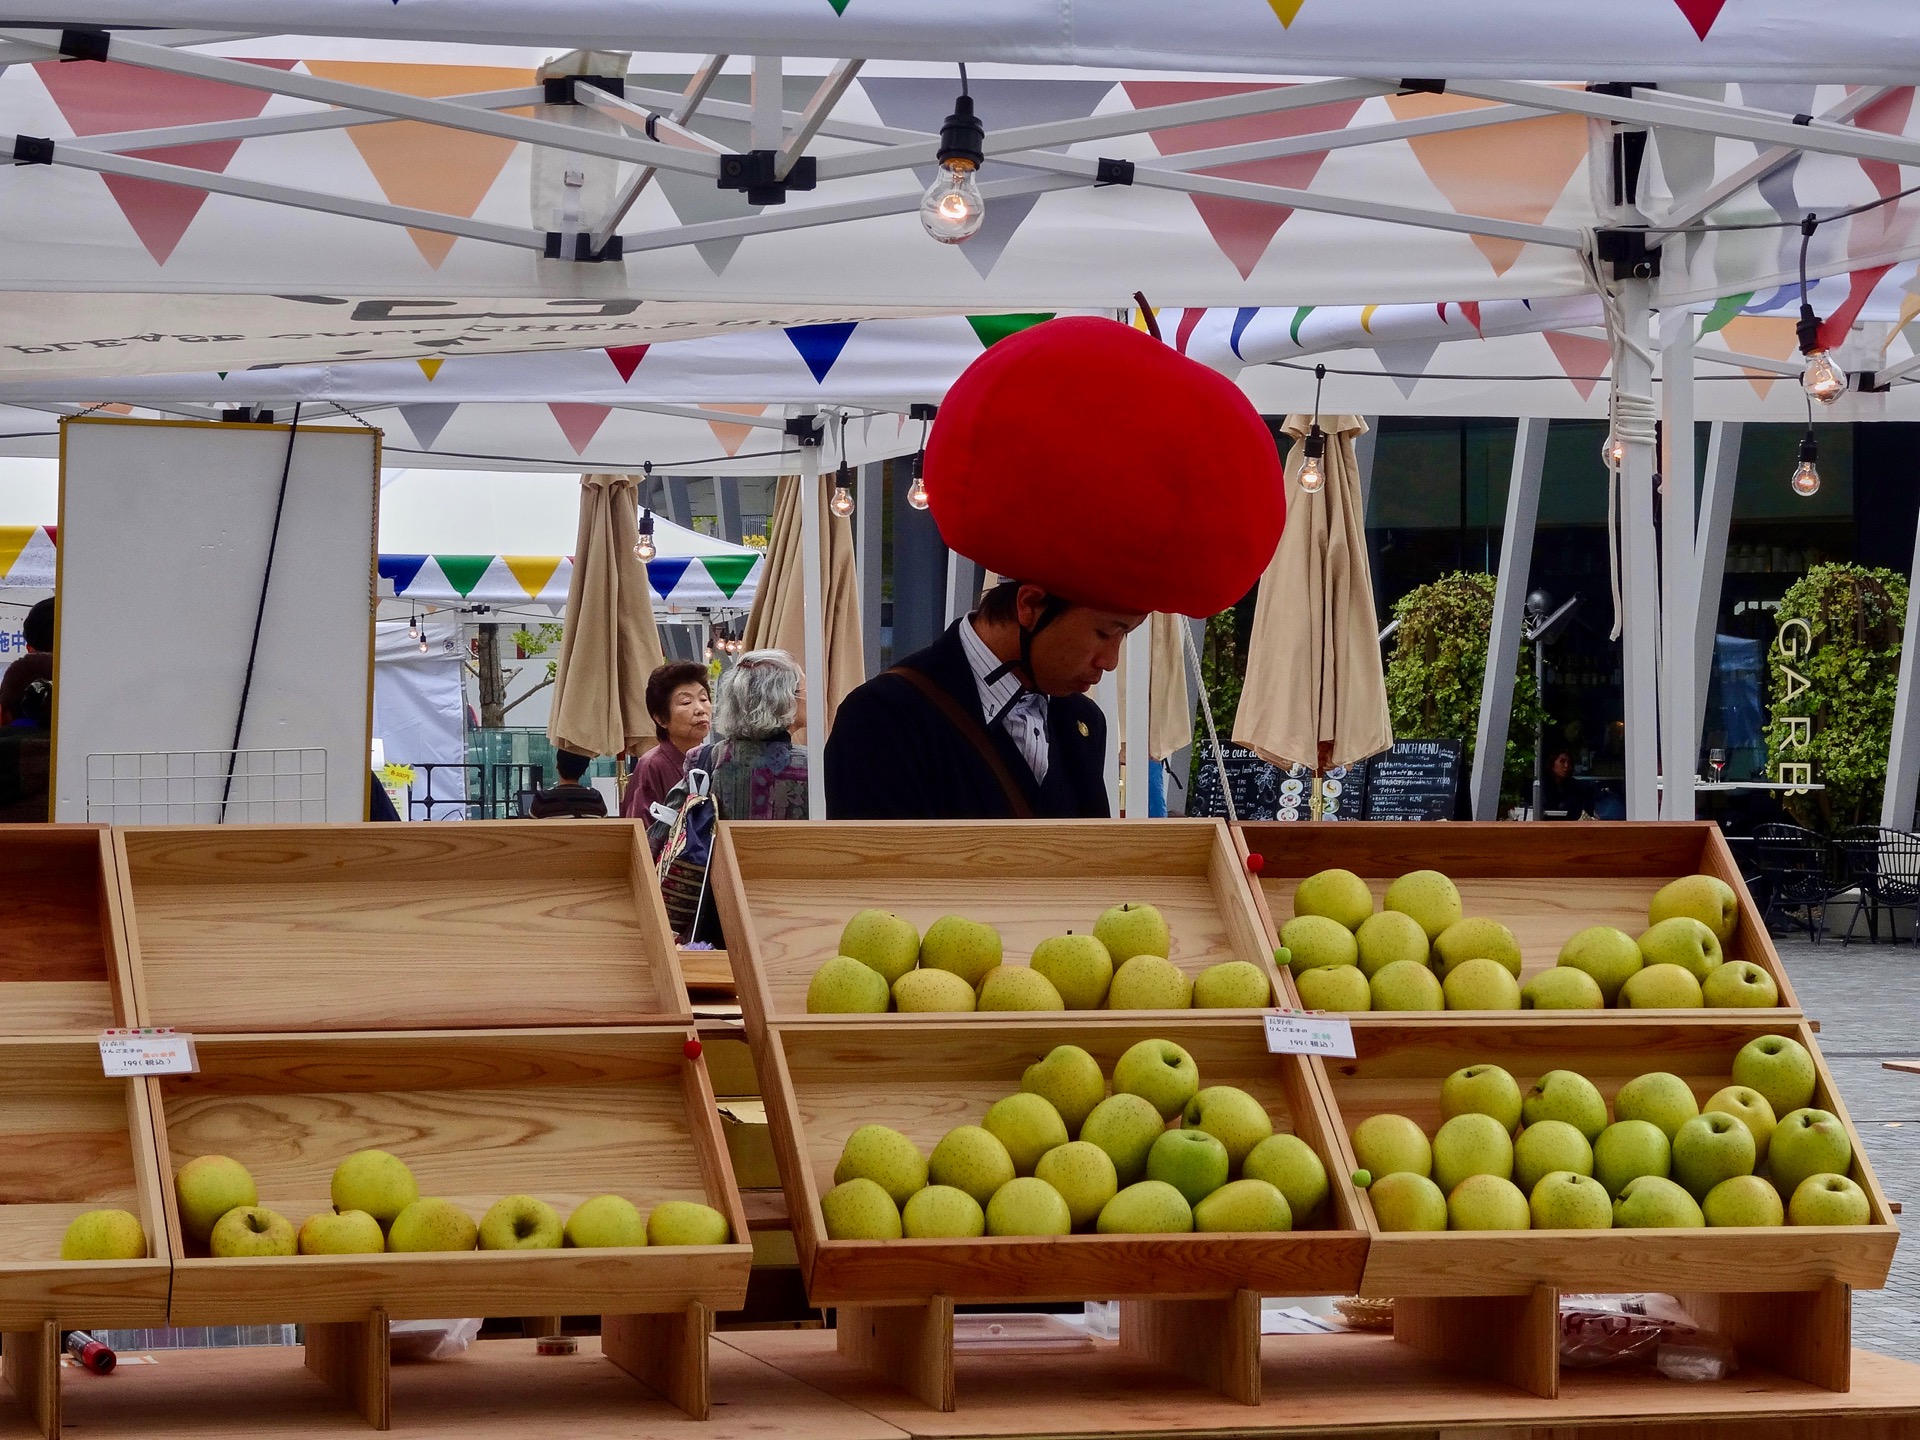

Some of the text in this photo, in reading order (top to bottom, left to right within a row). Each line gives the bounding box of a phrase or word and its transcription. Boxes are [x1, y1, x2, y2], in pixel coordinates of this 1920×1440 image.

[1208, 744, 1230, 758] Tke
[1232, 748, 1248, 758] out
[1392, 743, 1417, 755] LUNCH
[1418, 742, 1439, 755] MENU
